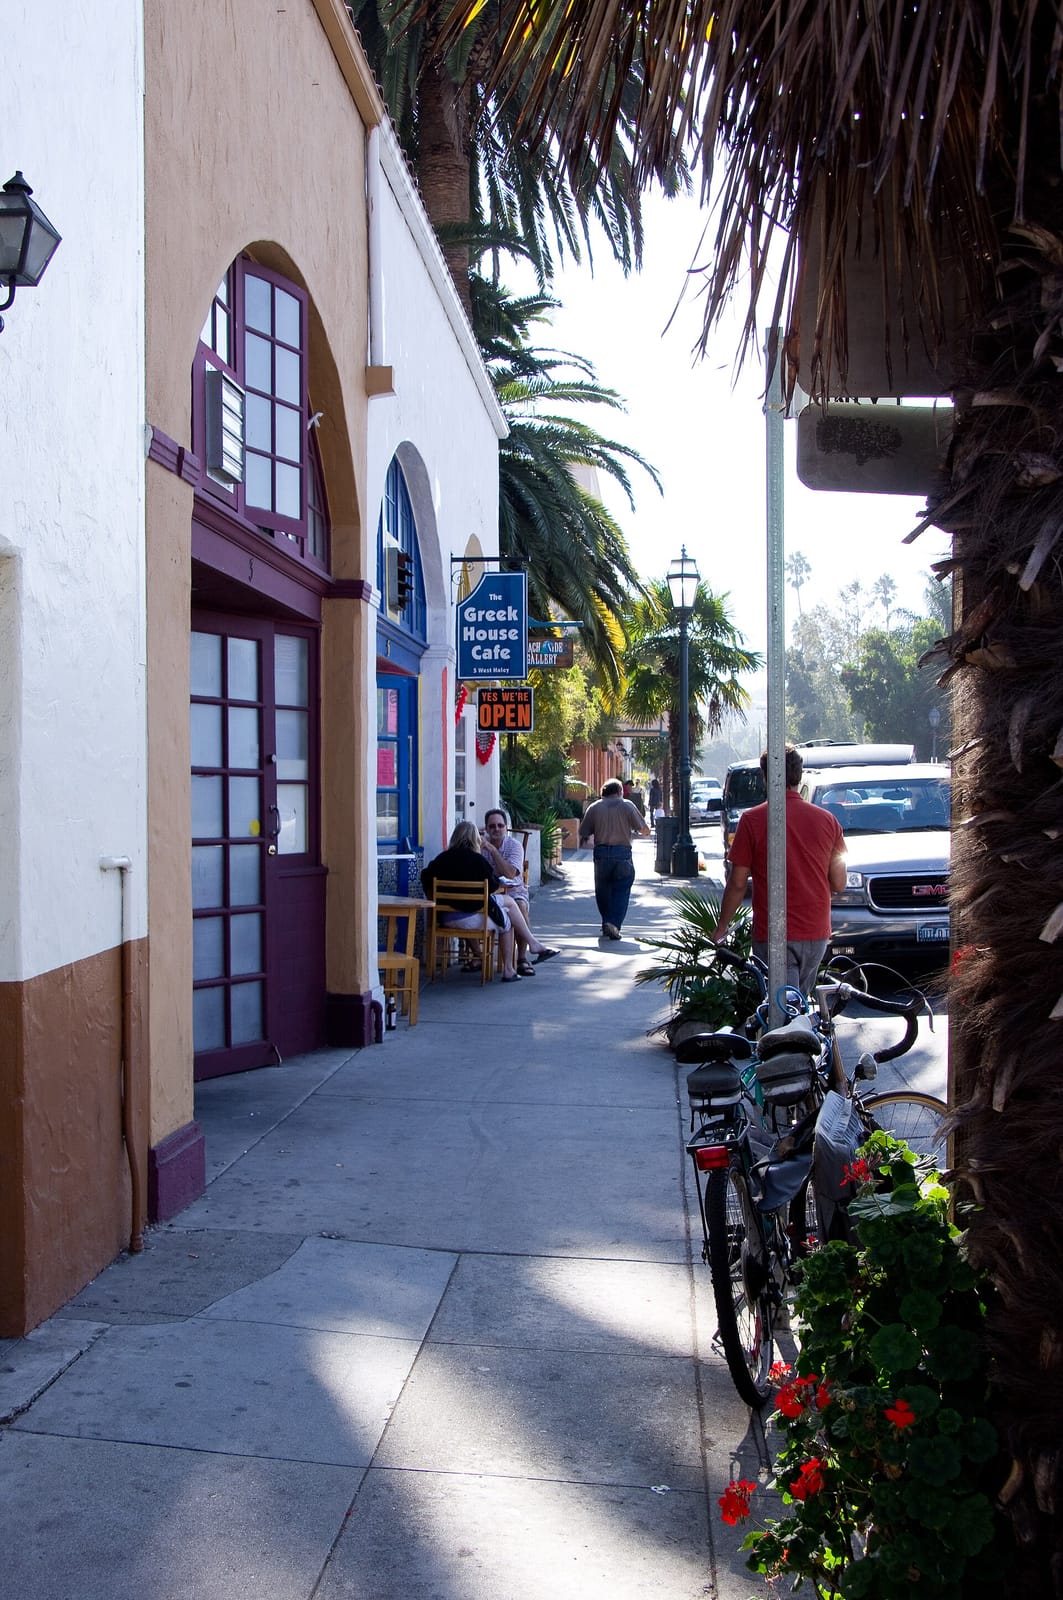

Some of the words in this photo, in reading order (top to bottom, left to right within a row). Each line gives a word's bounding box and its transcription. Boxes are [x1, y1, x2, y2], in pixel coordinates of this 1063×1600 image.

[488, 593, 502, 601] The
[463, 606, 519, 622] Greek
[463, 626, 519, 641] House
[471, 644, 511, 661] Cafe
[527, 641, 541, 653] ACH
[481, 692, 498, 702] YES
[501, 692, 529, 702] WE'RE
[479, 703, 531, 728] OPEN
